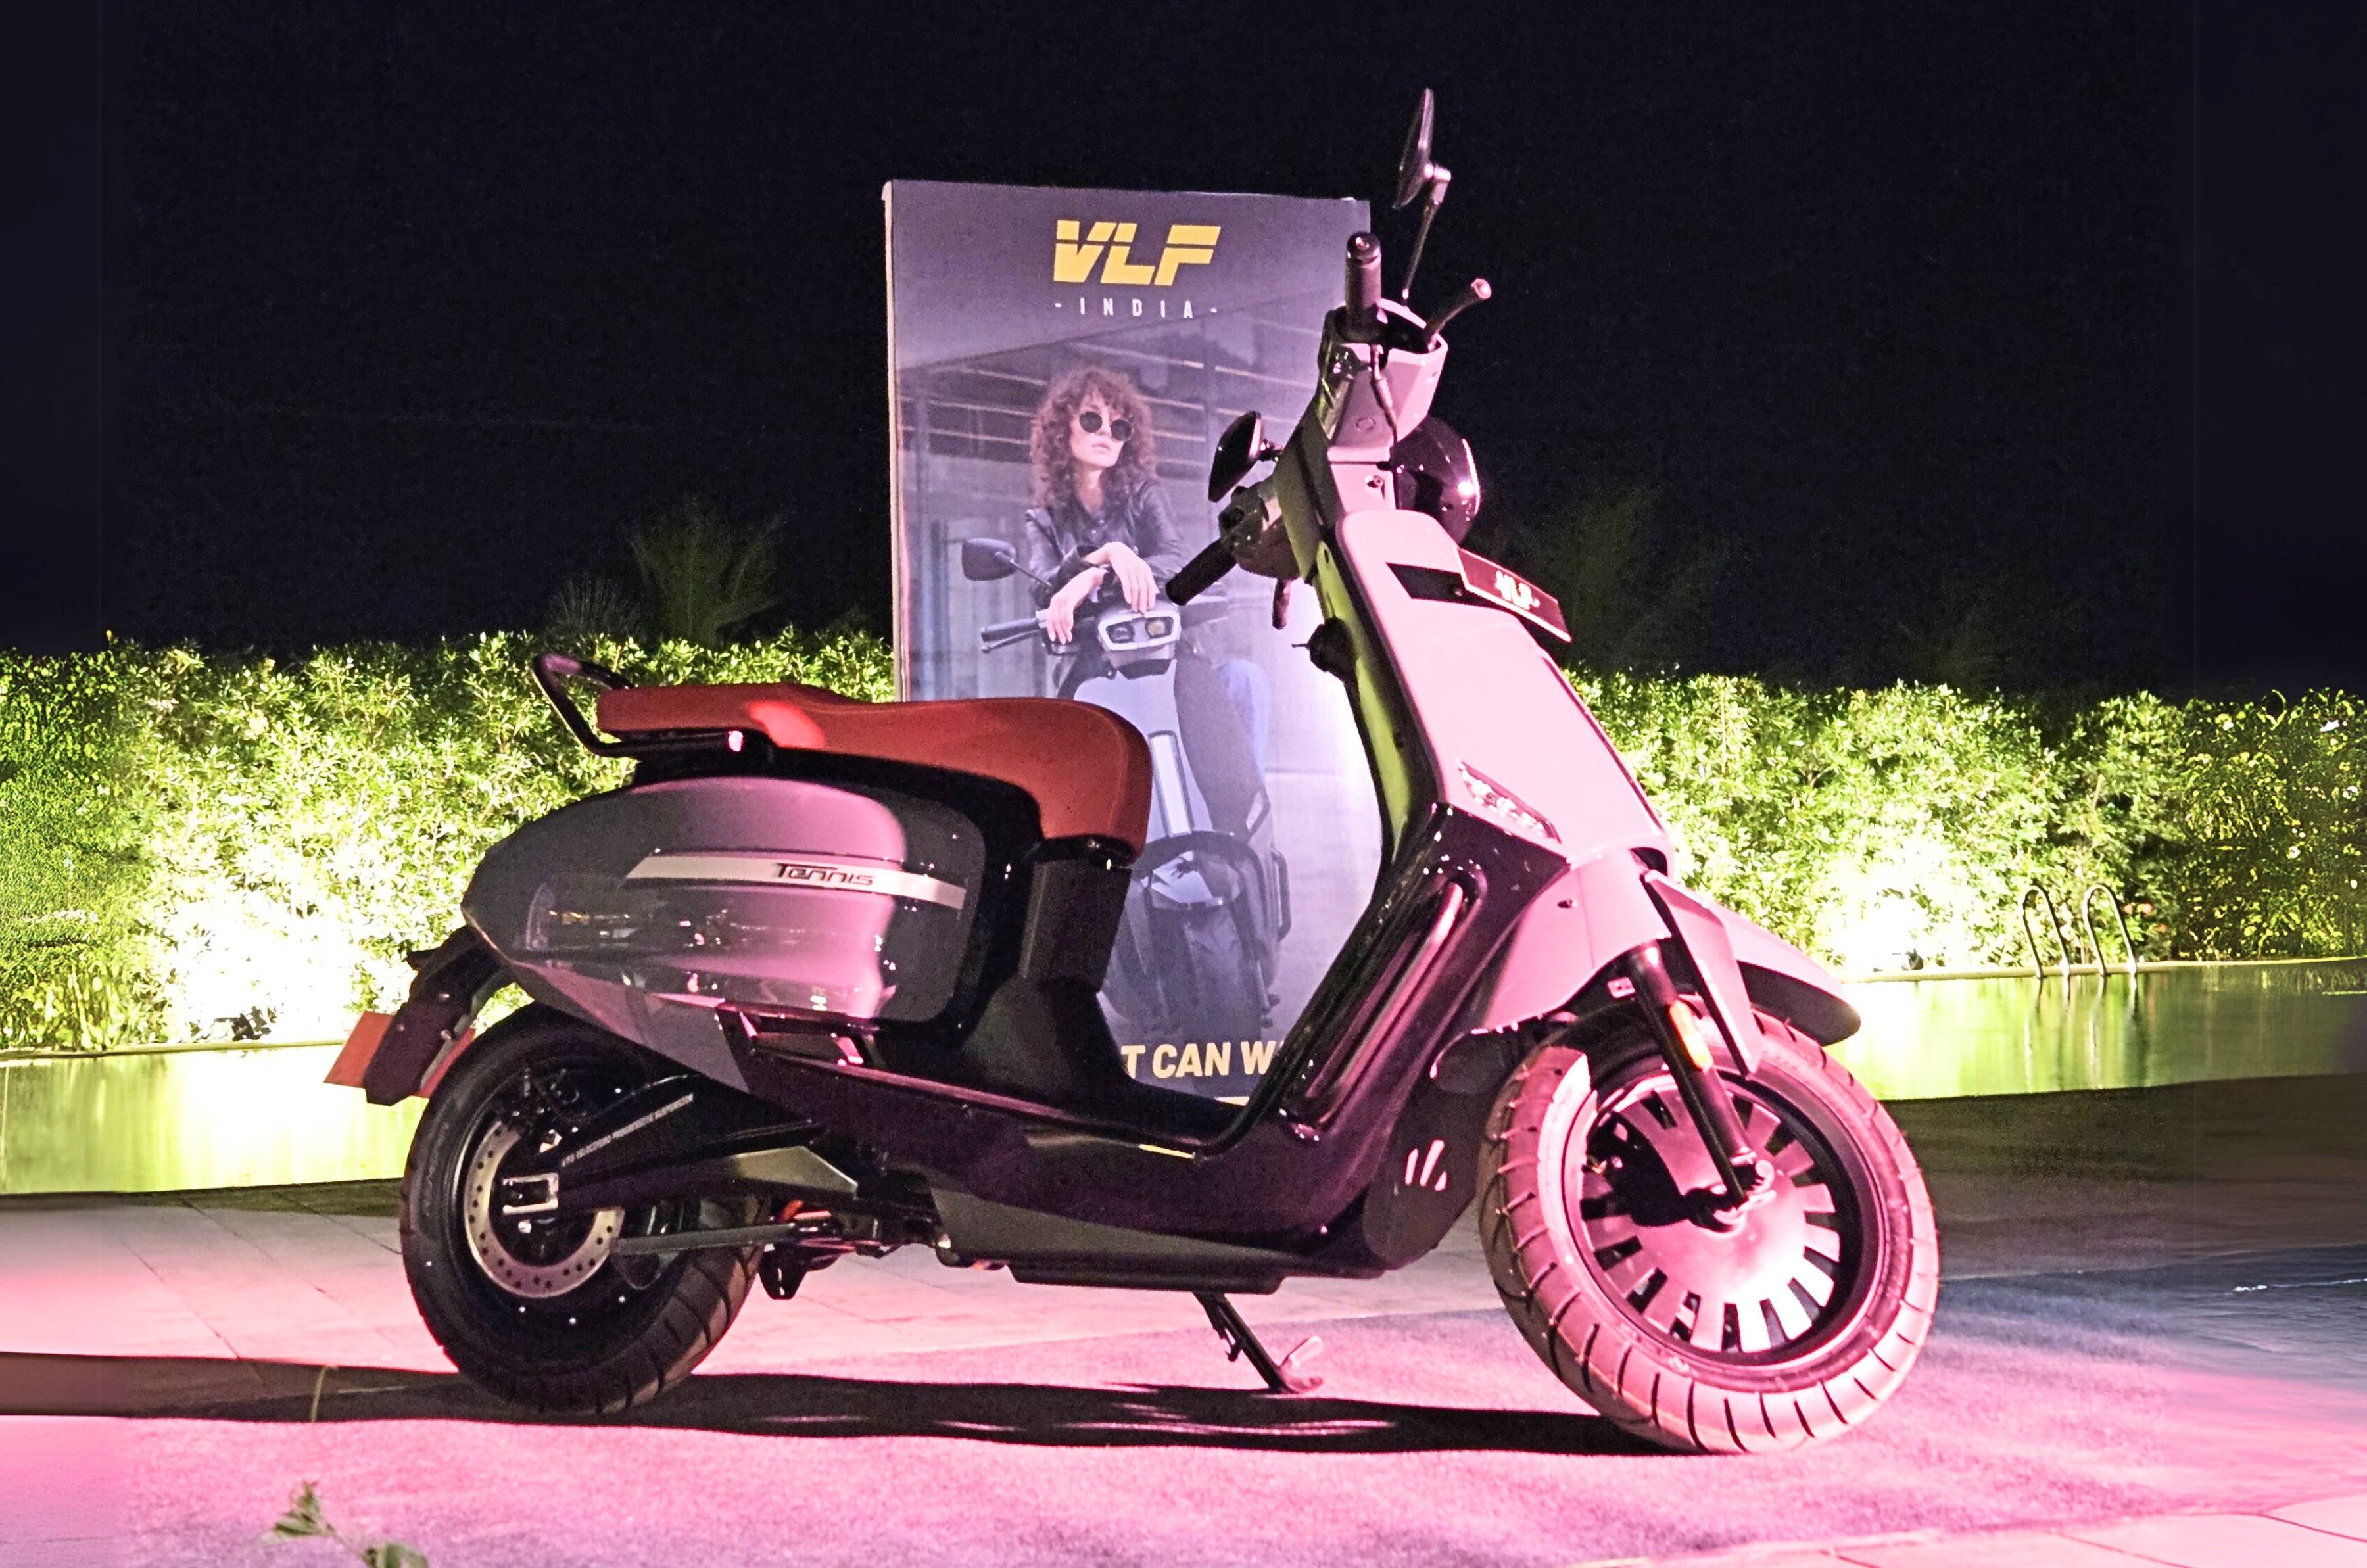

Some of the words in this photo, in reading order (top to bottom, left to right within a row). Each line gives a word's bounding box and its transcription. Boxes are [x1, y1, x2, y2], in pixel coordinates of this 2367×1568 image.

[1053, 219, 1221, 286] VLF
[775, 862, 875, 886] Tennis
[1152, 1042, 1231, 1078] CAN
[1240, 1040, 1284, 1075] W
